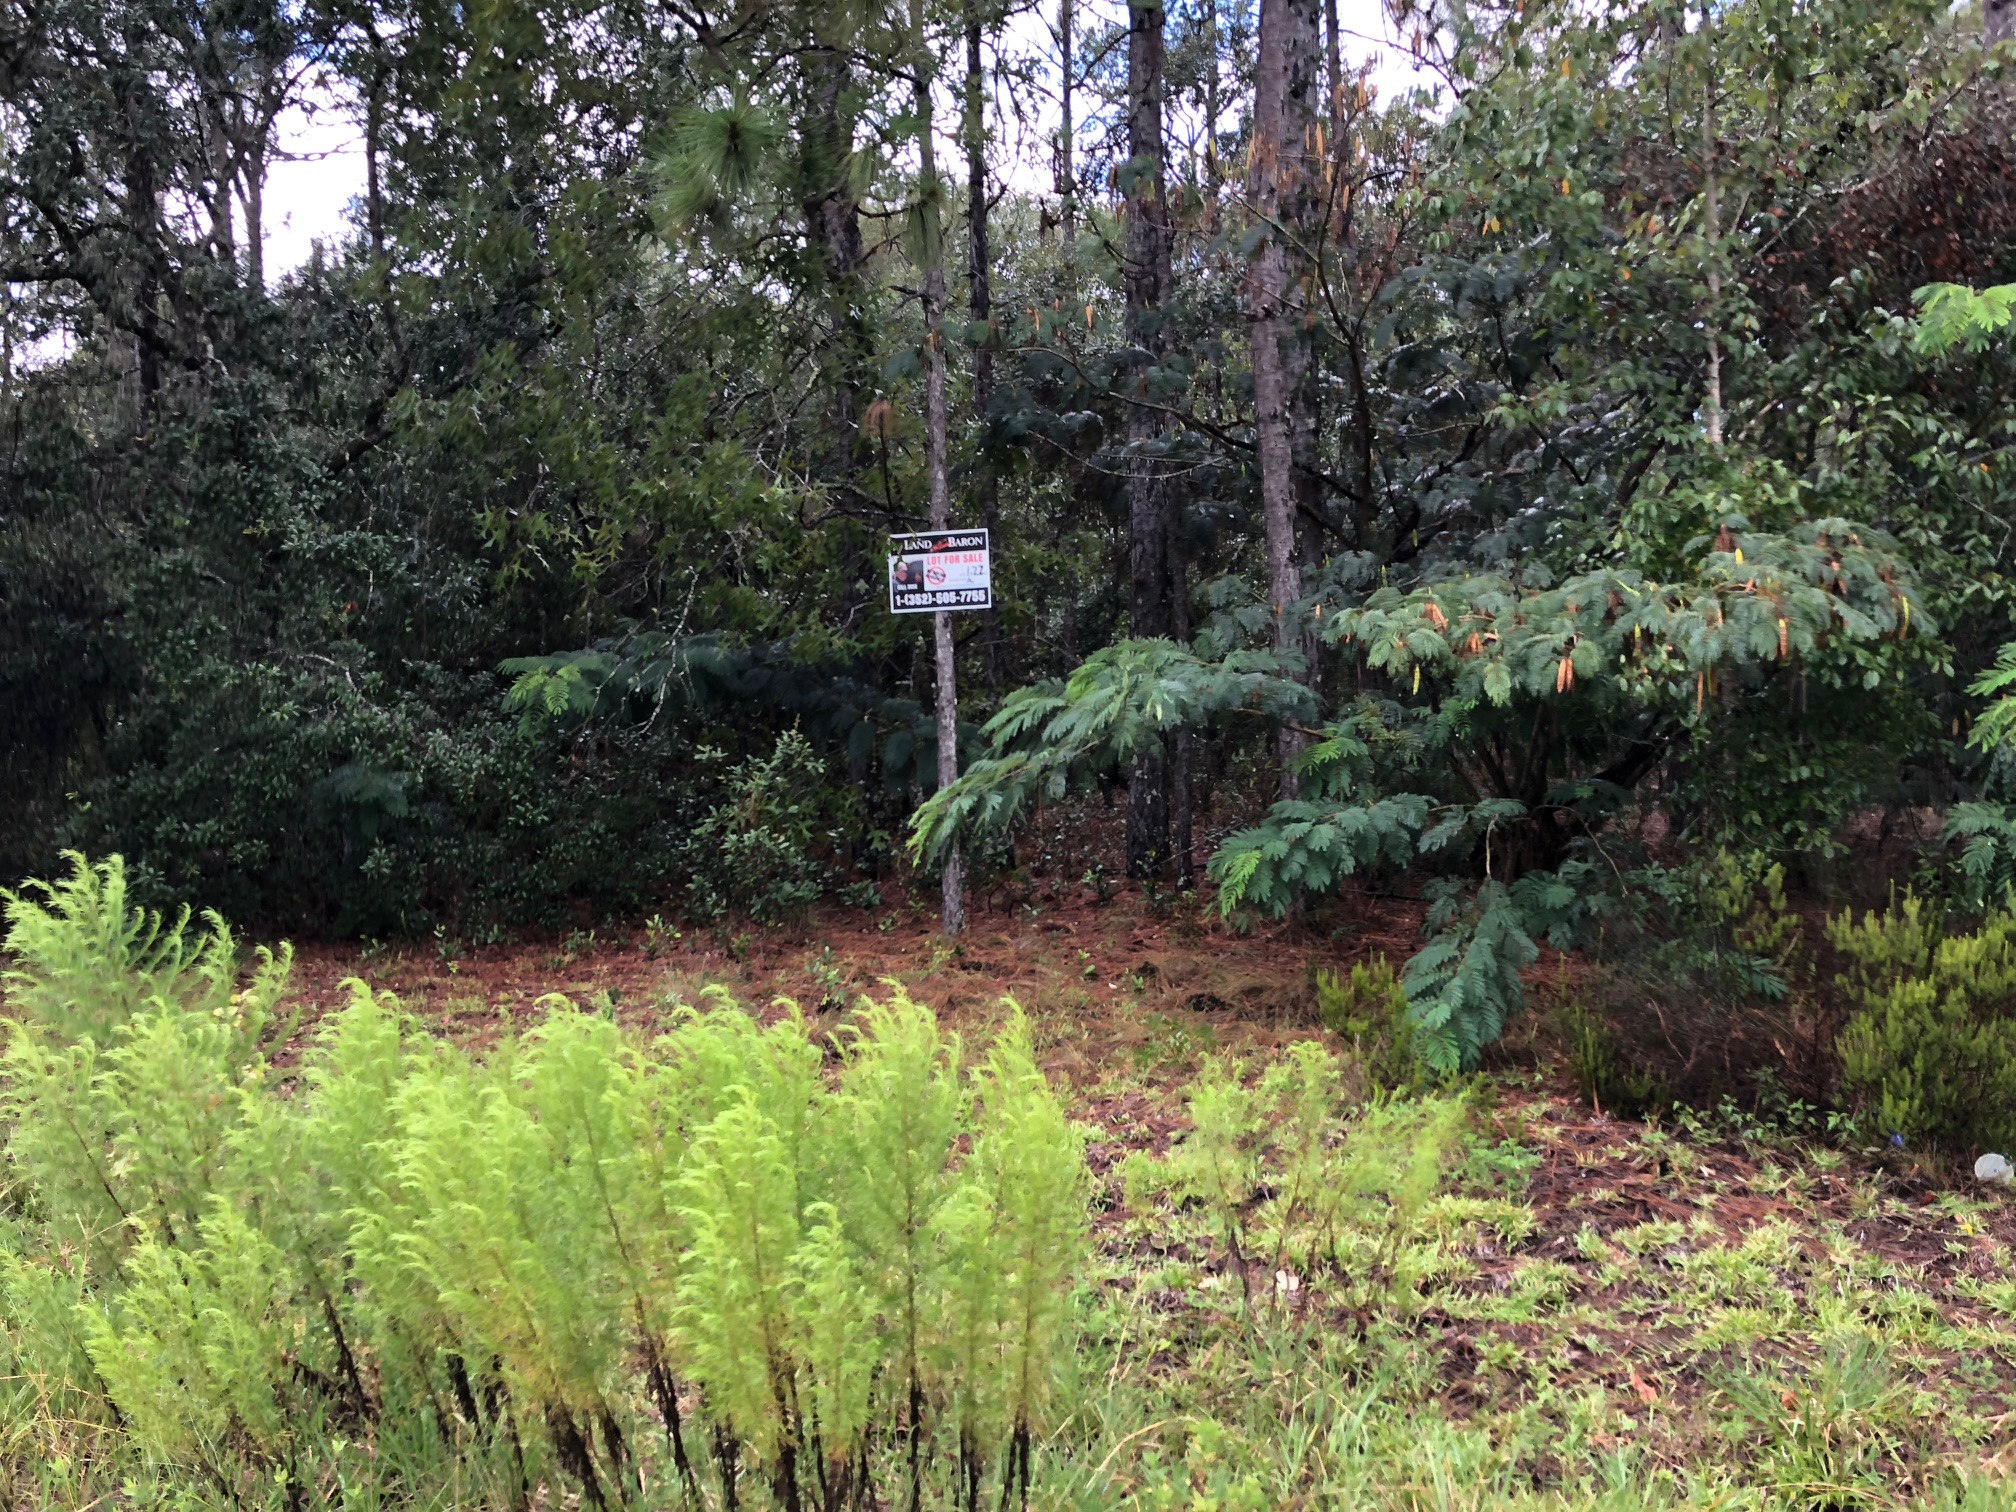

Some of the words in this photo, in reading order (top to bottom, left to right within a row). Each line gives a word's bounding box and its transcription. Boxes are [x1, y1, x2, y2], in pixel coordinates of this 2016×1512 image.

[904, 539, 932, 550] LAND
[947, 536, 983, 548] BARON
[927, 556, 941, 565] LOT
[945, 554, 960, 564] FOR
[963, 553, 983, 563] SALE
